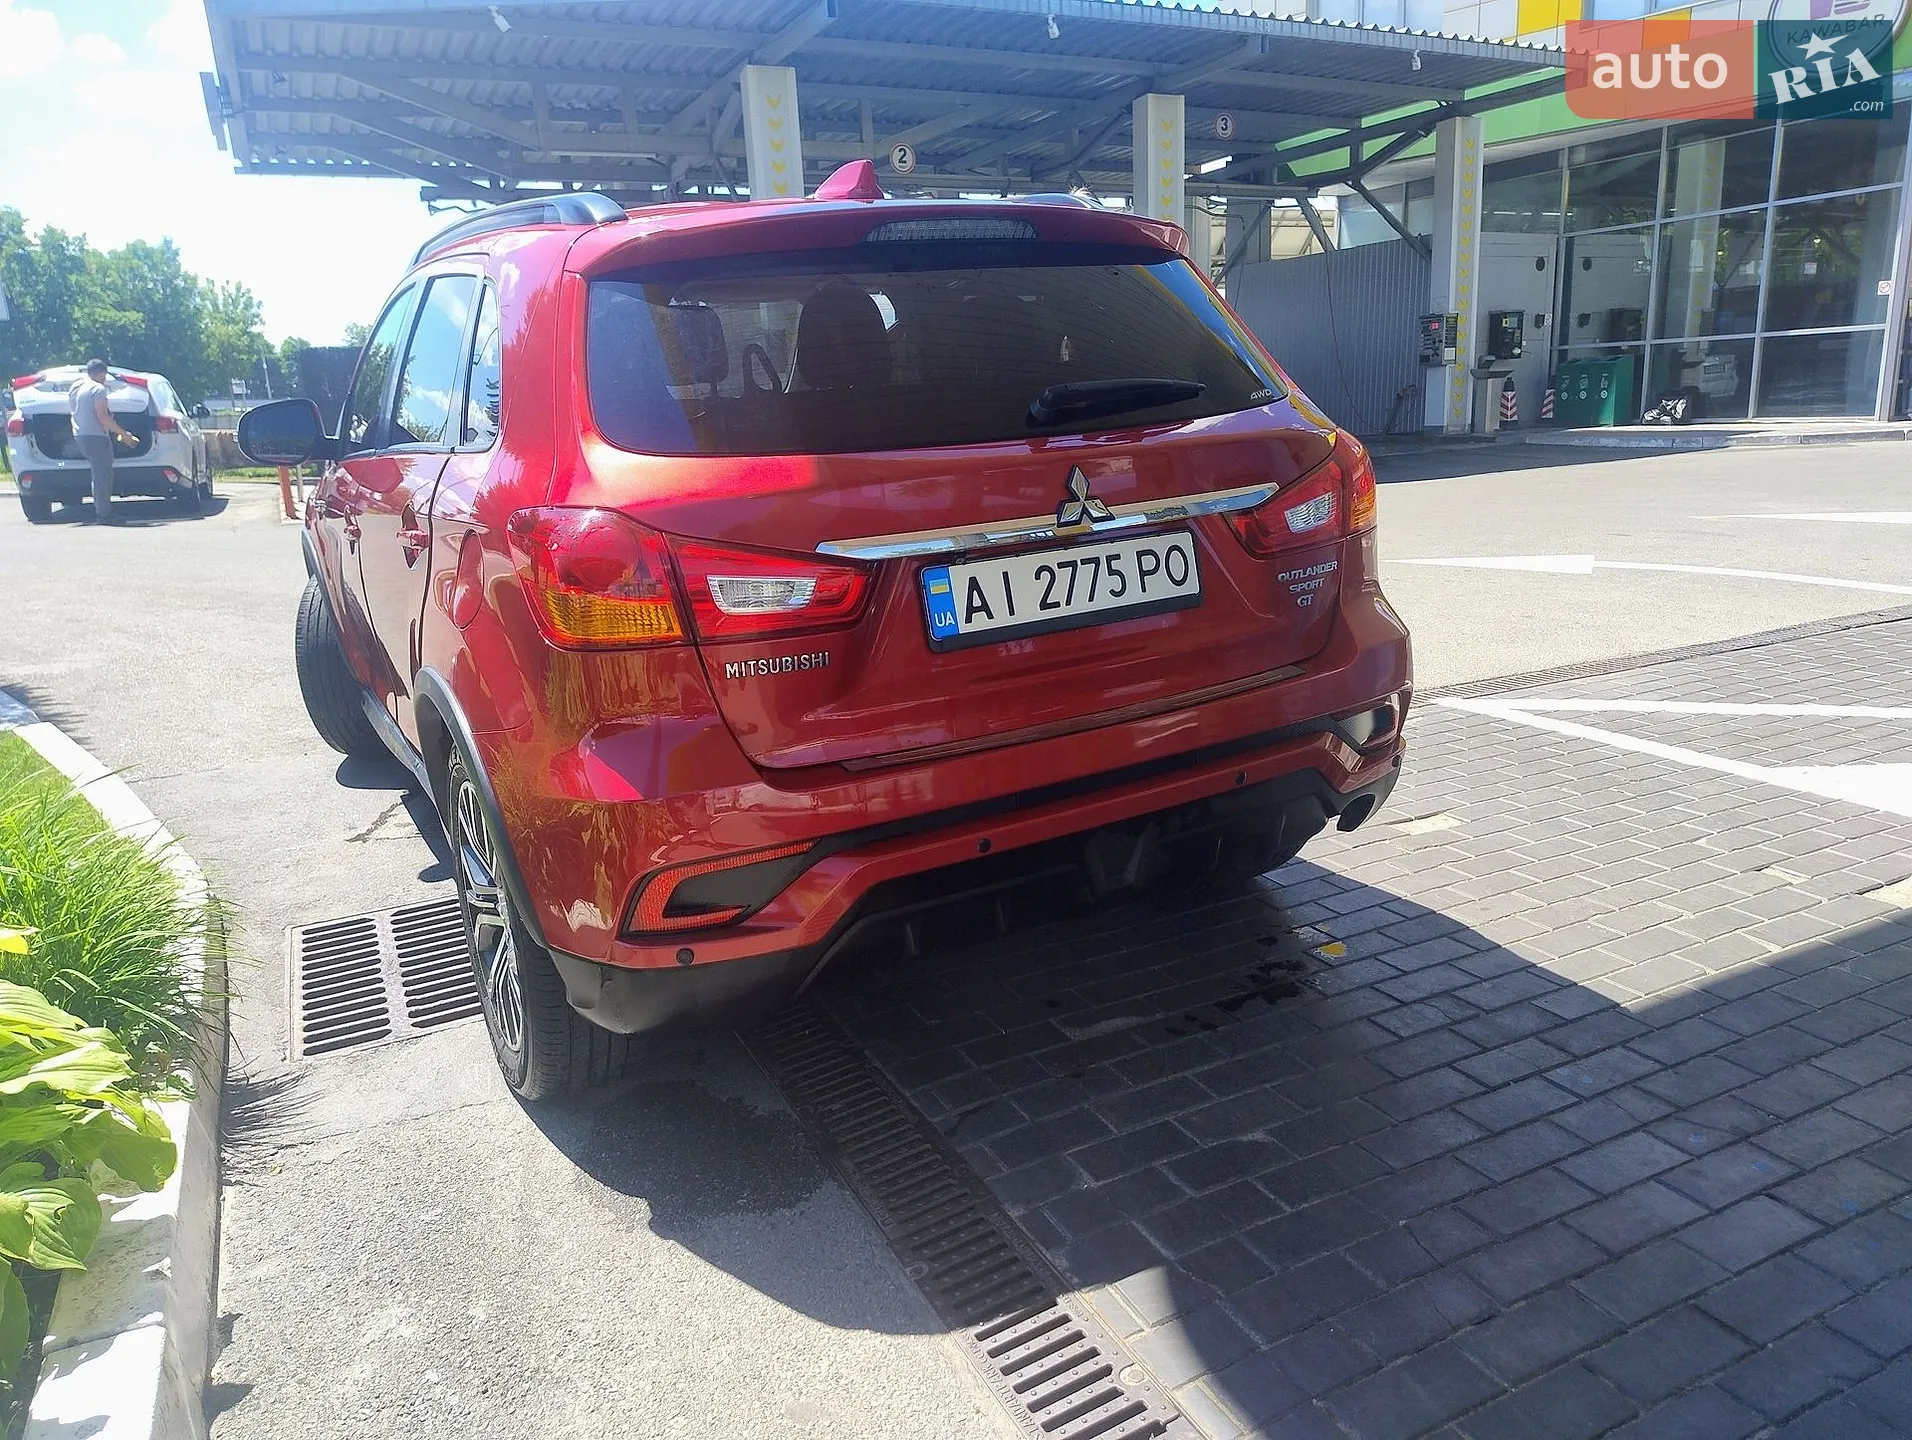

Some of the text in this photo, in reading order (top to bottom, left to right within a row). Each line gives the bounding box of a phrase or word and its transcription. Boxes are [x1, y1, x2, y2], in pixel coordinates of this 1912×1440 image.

[1786, 14, 1885, 45] KAWABAR
[1220, 116, 1229, 132] 3
[898, 147, 908, 165] 2
[1250, 388, 1273, 400] 4WD
[1277, 560, 1339, 583] OUTLANDER
[964, 544, 1190, 625] AI 2775 PO
[1289, 578, 1325, 594] SPORT
[1297, 593, 1314, 608] GT
[934, 612, 956, 627] UA
[725, 651, 830, 679] MITSUBISHI
